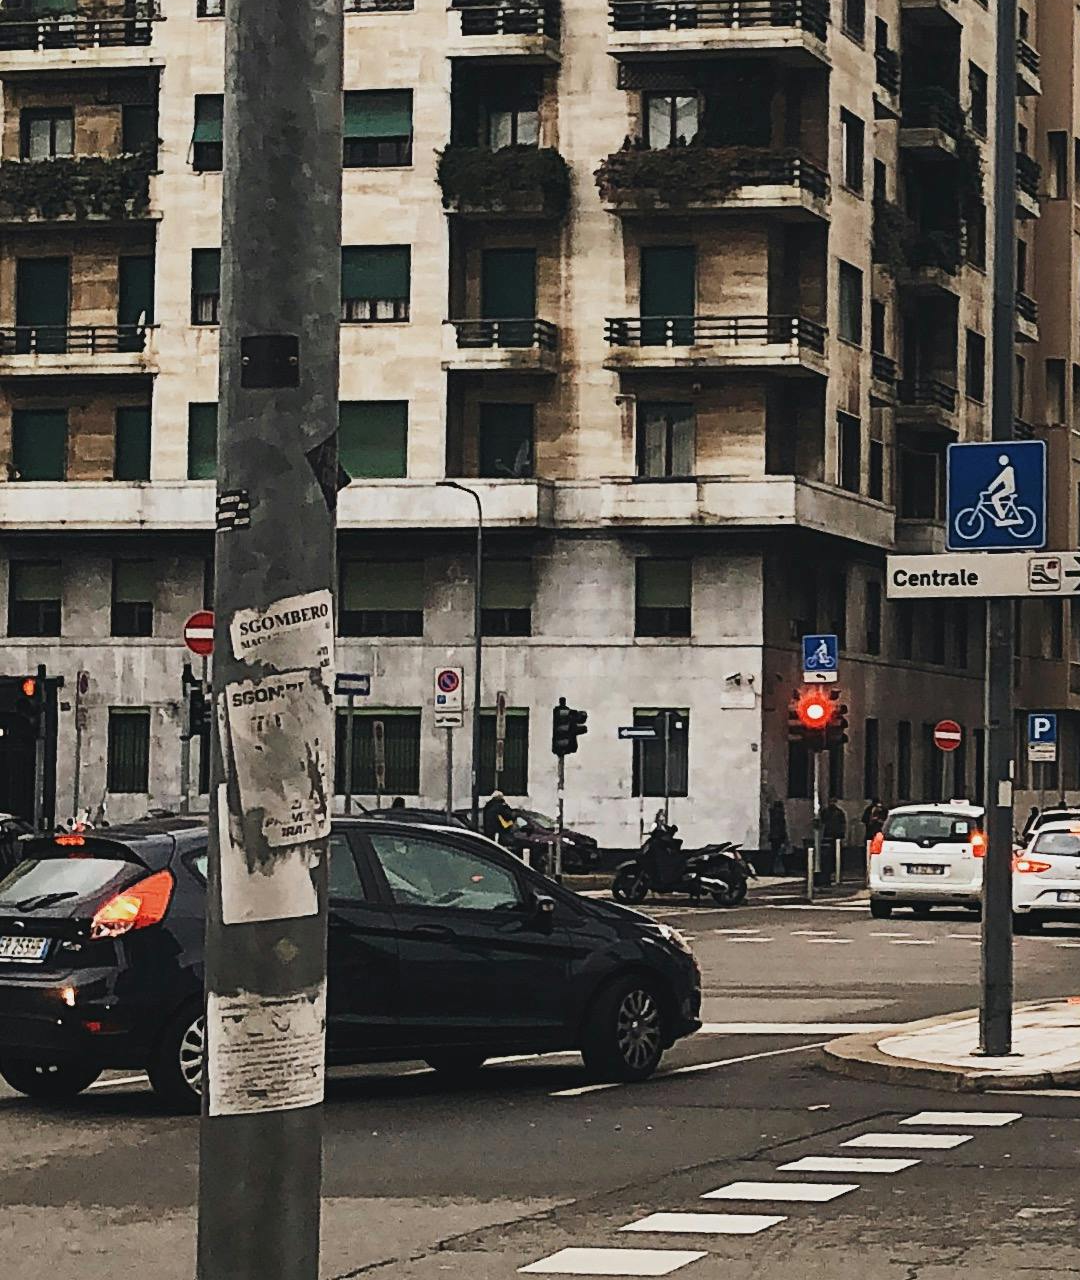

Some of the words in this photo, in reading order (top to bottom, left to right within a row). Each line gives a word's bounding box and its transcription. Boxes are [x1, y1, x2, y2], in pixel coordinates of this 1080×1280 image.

[893, 569, 979, 587] Centrale
[240, 603, 328, 636] SGOMBERO
[1034, 717, 1051, 739] P
